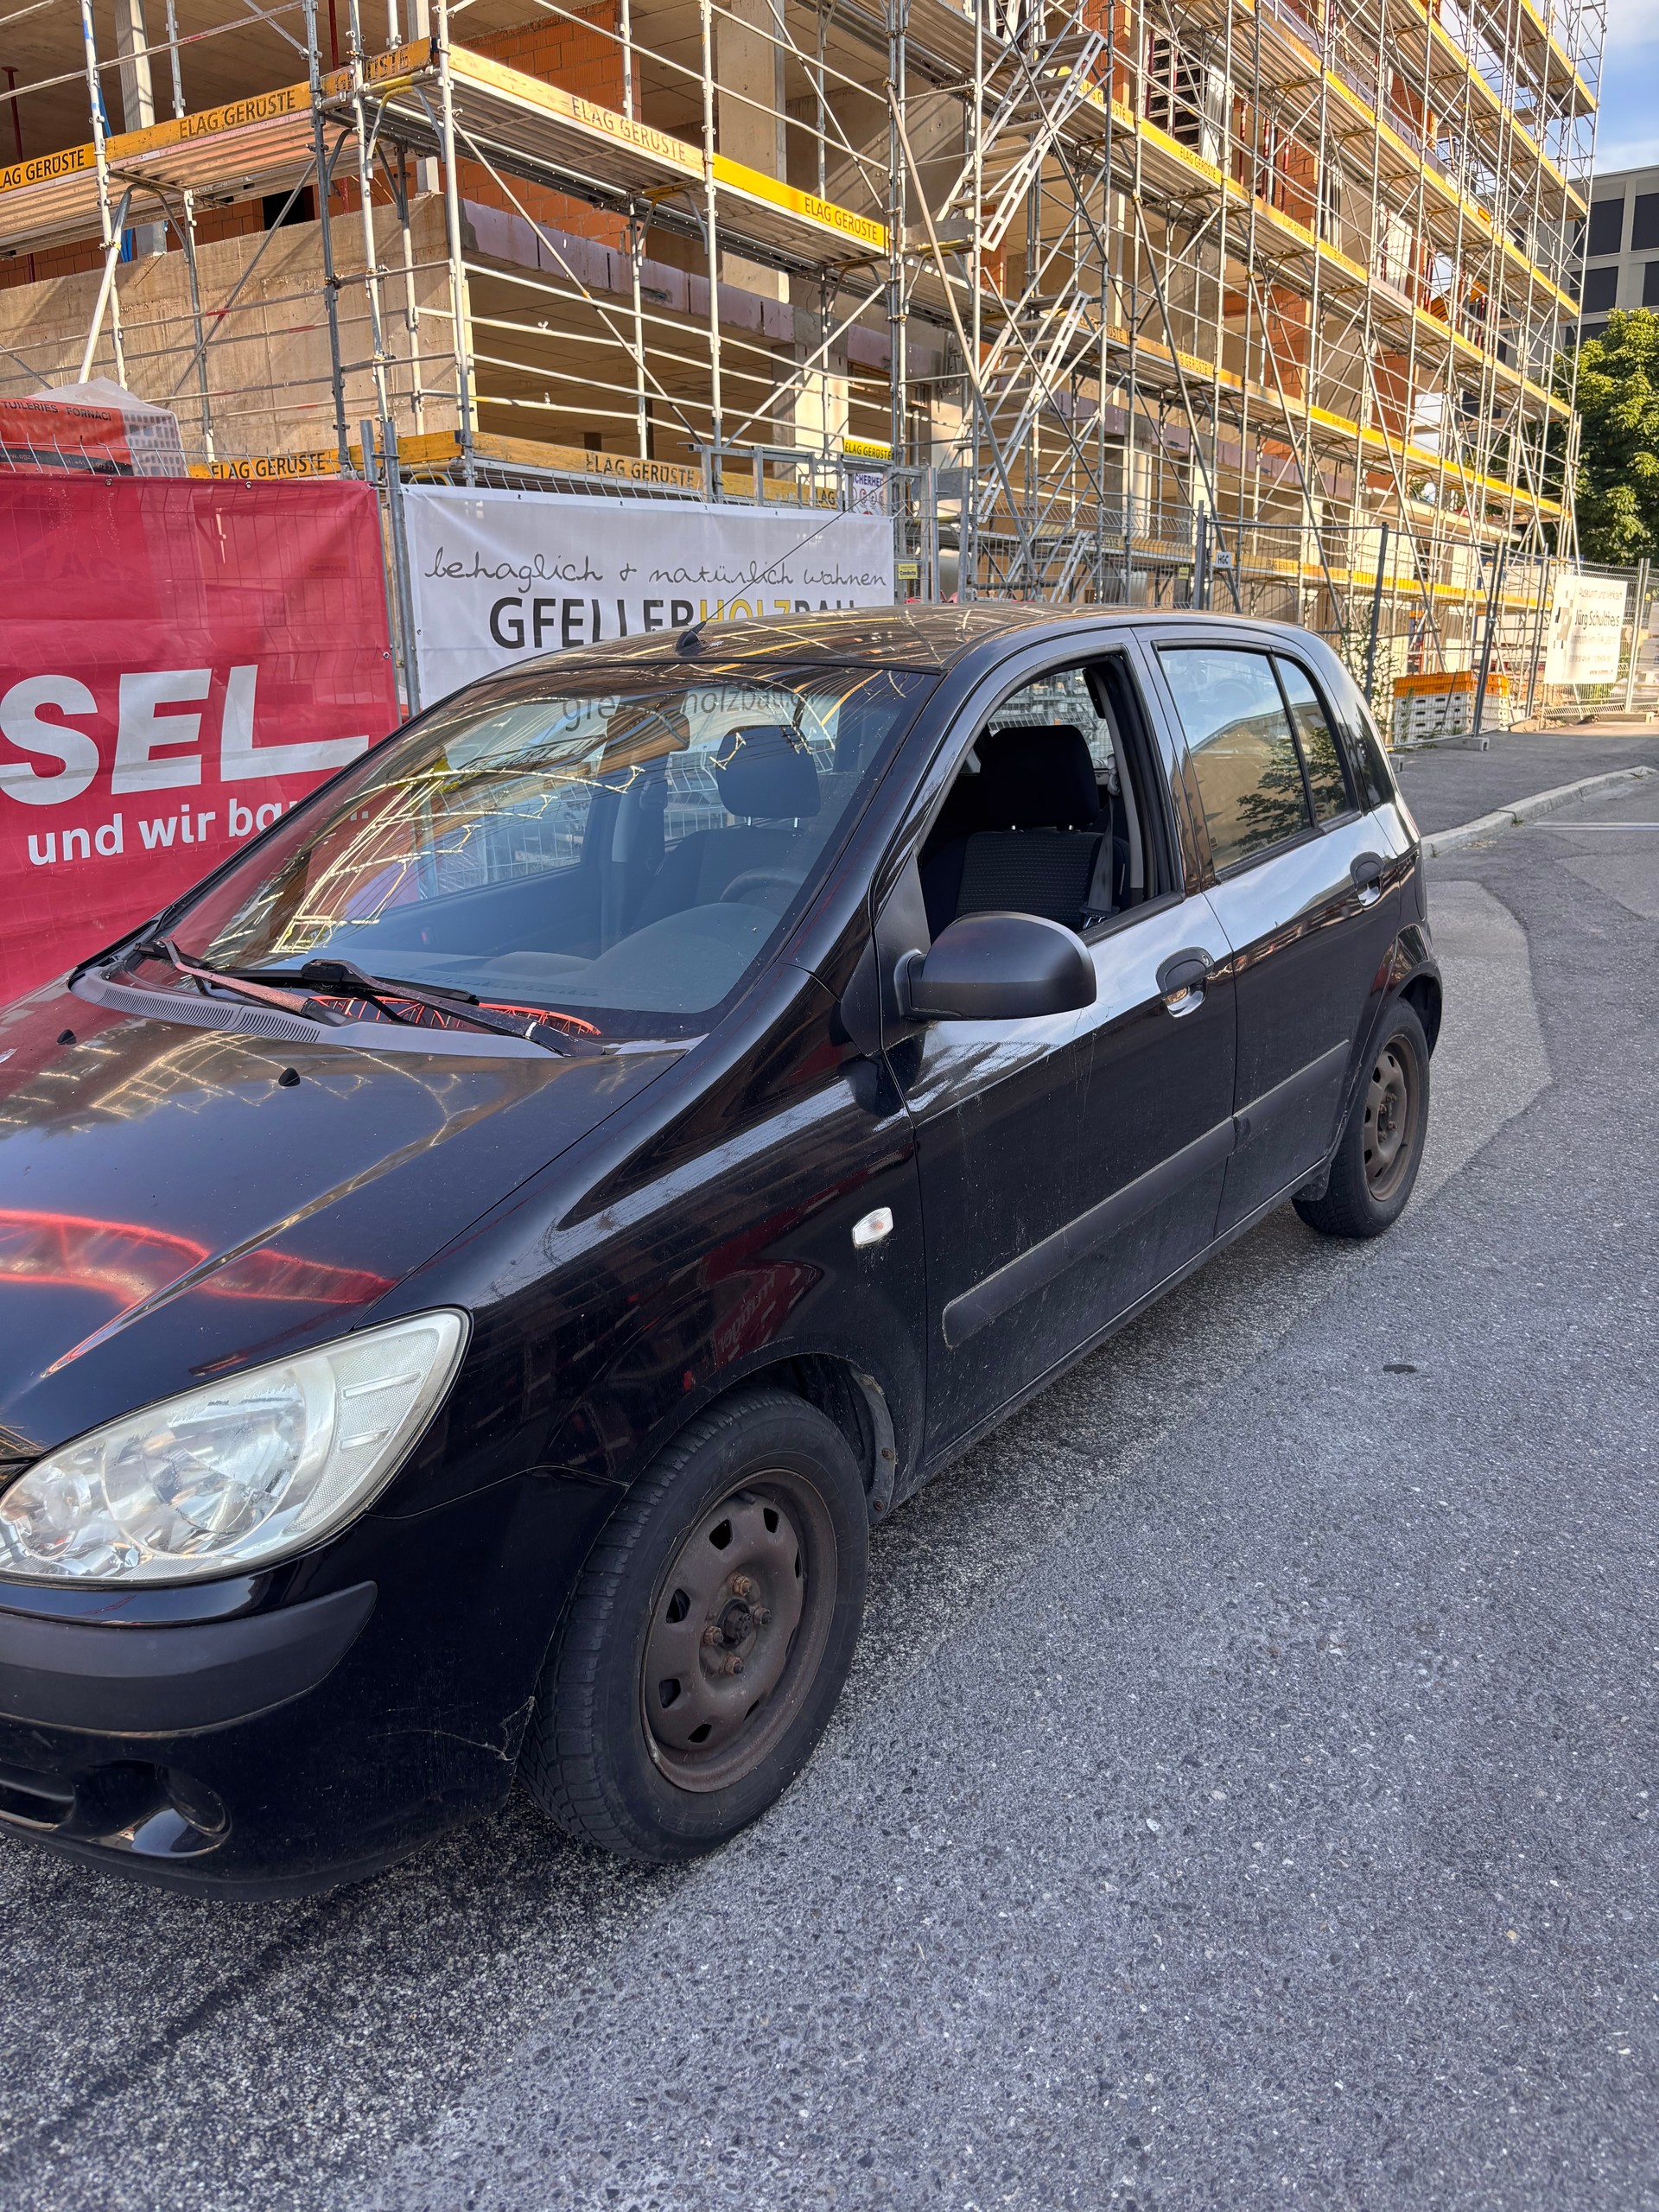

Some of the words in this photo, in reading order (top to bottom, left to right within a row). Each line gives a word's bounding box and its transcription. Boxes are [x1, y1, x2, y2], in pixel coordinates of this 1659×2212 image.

[179, 111, 219, 140] ELAG
[224, 89, 296, 126] GERÜSTE
[571, 96, 614, 131] ELAG
[620, 118, 686, 162] GERÜSTE
[0, 168, 21, 188] AG
[25, 148, 85, 181] GERÜSTE
[1180, 146, 1193, 164] ELAG
[804, 197, 831, 221] ELAG
[835, 210, 877, 241] GERÜSTE
[2, 400, 59, 414] TUILERIES
[66, 406, 111, 422] FORNACI
[256, 452, 326, 478] GERÜSTE
[844, 442, 862, 455] ELAG
[585, 452, 626, 475] ELAG
[631, 461, 695, 487] GERÜSTE
[424, 545, 603, 594] behaglich
[649, 560, 793, 585] natürlich
[804, 563, 887, 586] wohnen
[1217, 555, 1229, 564] HGC
[1574, 609, 1588, 630] Jürg
[0, 664, 370, 805] SEL
[28, 812, 123, 865] und
[138, 804, 216, 849] wir
